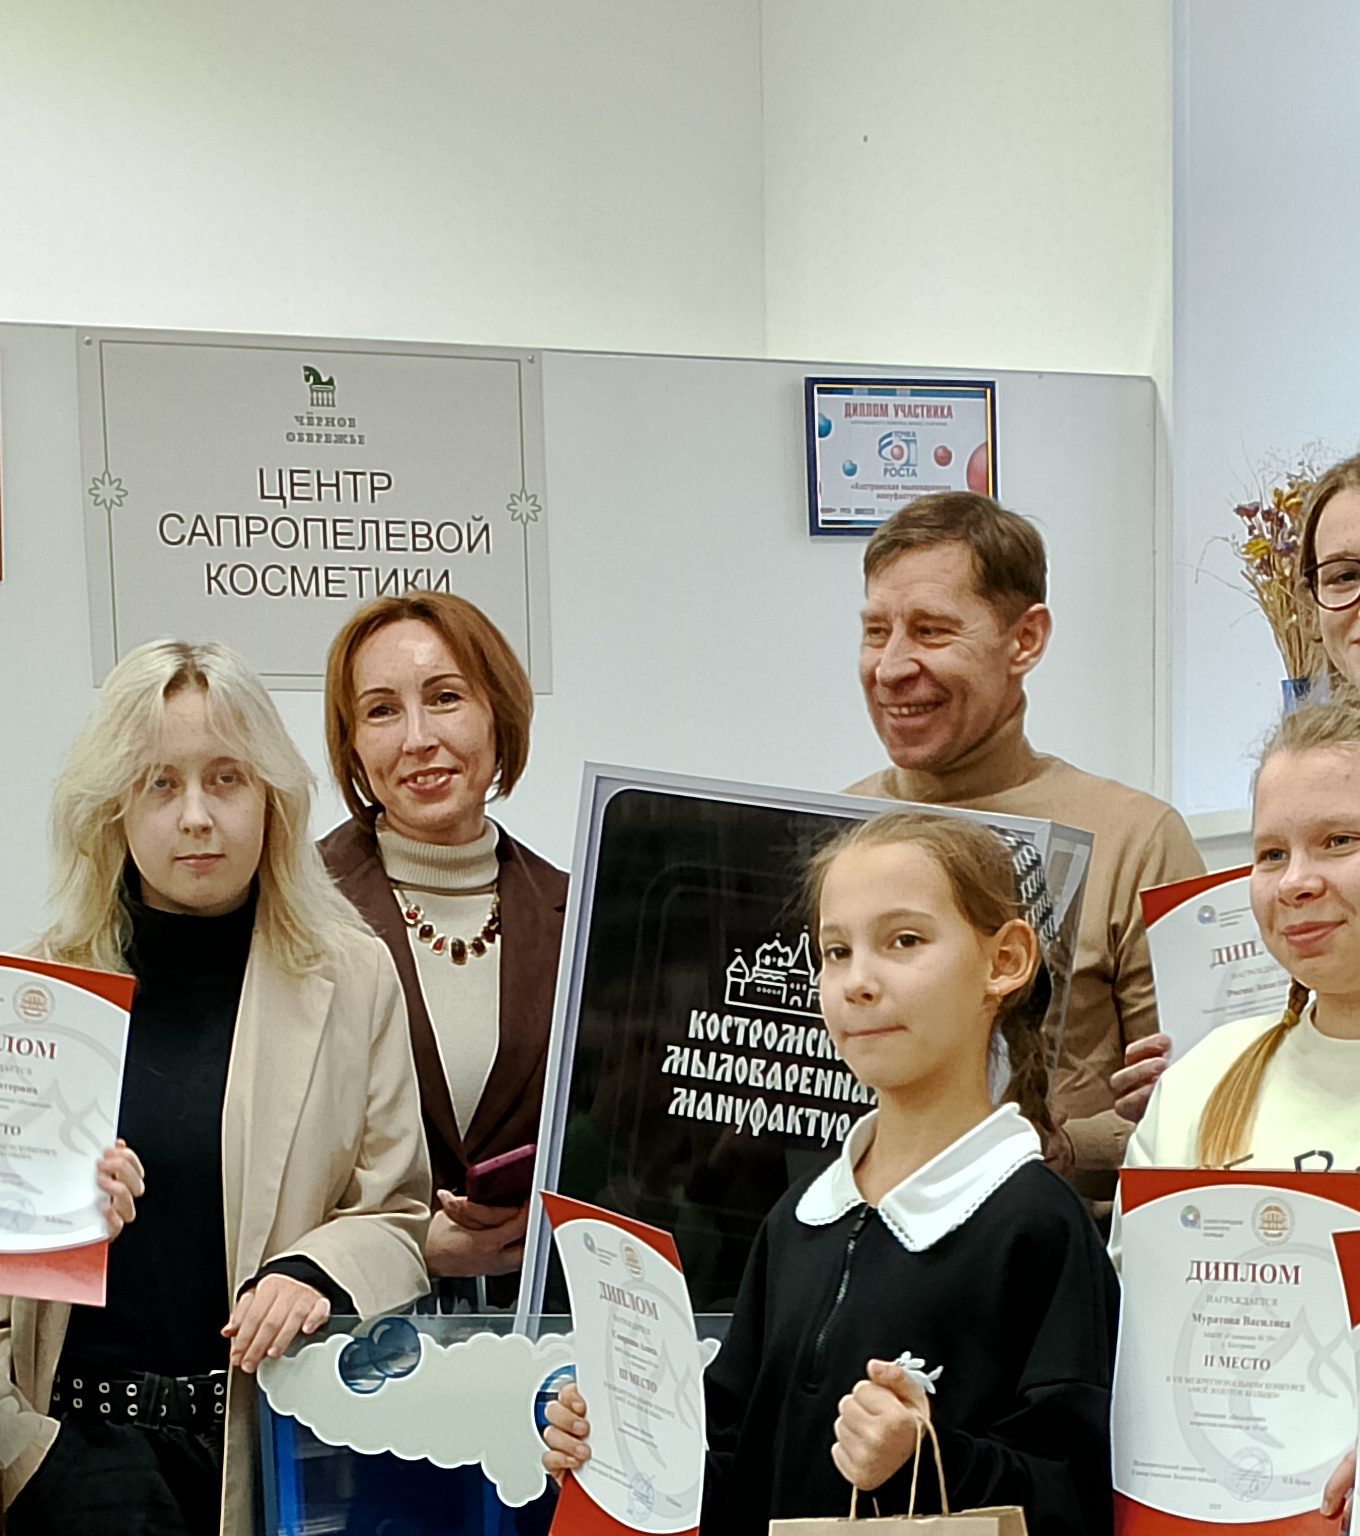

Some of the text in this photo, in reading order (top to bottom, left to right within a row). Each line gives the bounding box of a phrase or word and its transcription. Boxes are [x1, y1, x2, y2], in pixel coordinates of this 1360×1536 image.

[293, 411, 356, 428] ЧЁРНОЕ
[845, 402, 953, 419] ДИПЛОМ УЧАСТНИКА
[285, 432, 365, 445] ОБЕРЕЖЬЕ
[883, 468, 917, 477] РОСТА
[257, 467, 393, 508] ЦЕНТР
[158, 513, 491, 554] САПРОПЕЛЕВОЙ
[205, 563, 451, 598] КОСМЕТИКИ
[1210, 940, 1265, 970] ДИП
[688, 1009, 843, 1061] КОСТРОМСК
[668, 1087, 851, 1148] МАНУФАКТУР
[1185, 1260, 1301, 1286] ДИПЛОМ
[598, 1280, 659, 1320] ДИПЛОМ
[1206, 1294, 1278, 1307] НАГРАЖДАЕТСЯ
[1192, 1312, 1291, 1329] Муратова Василиса
[1204, 1355, 1271, 1371] II МЕСТО
